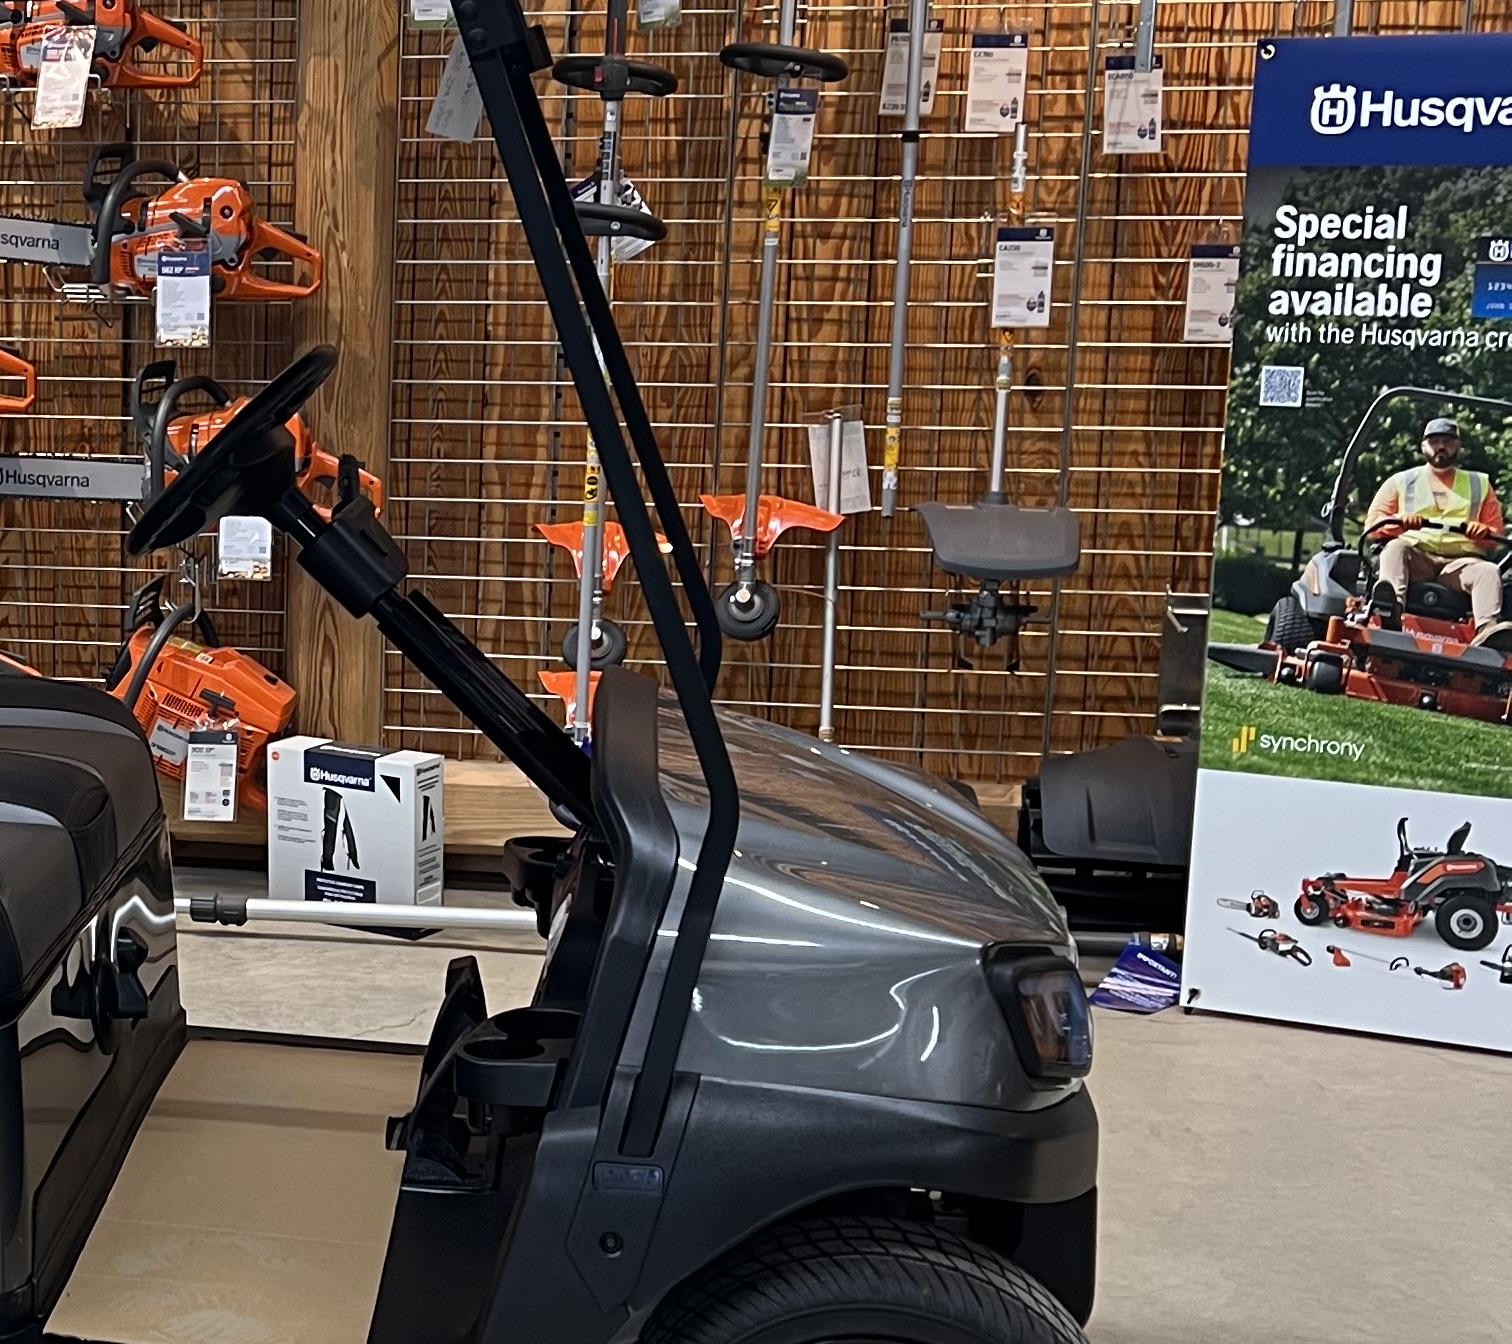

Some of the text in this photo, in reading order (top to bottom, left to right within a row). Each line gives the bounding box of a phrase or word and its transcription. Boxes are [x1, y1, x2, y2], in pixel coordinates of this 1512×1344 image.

[1274, 205, 1408, 246] Special
[1271, 245, 1443, 287] financing
[1268, 283, 1434, 318] available
[1266, 322, 1312, 344] with
[1318, 322, 1354, 344] the
[1360, 323, 1479, 351] Husqvarna
[4, 465, 91, 491] Husqvarna
[1260, 732, 1366, 762] synchrony
[320, 769, 371, 788] Husqvarna
